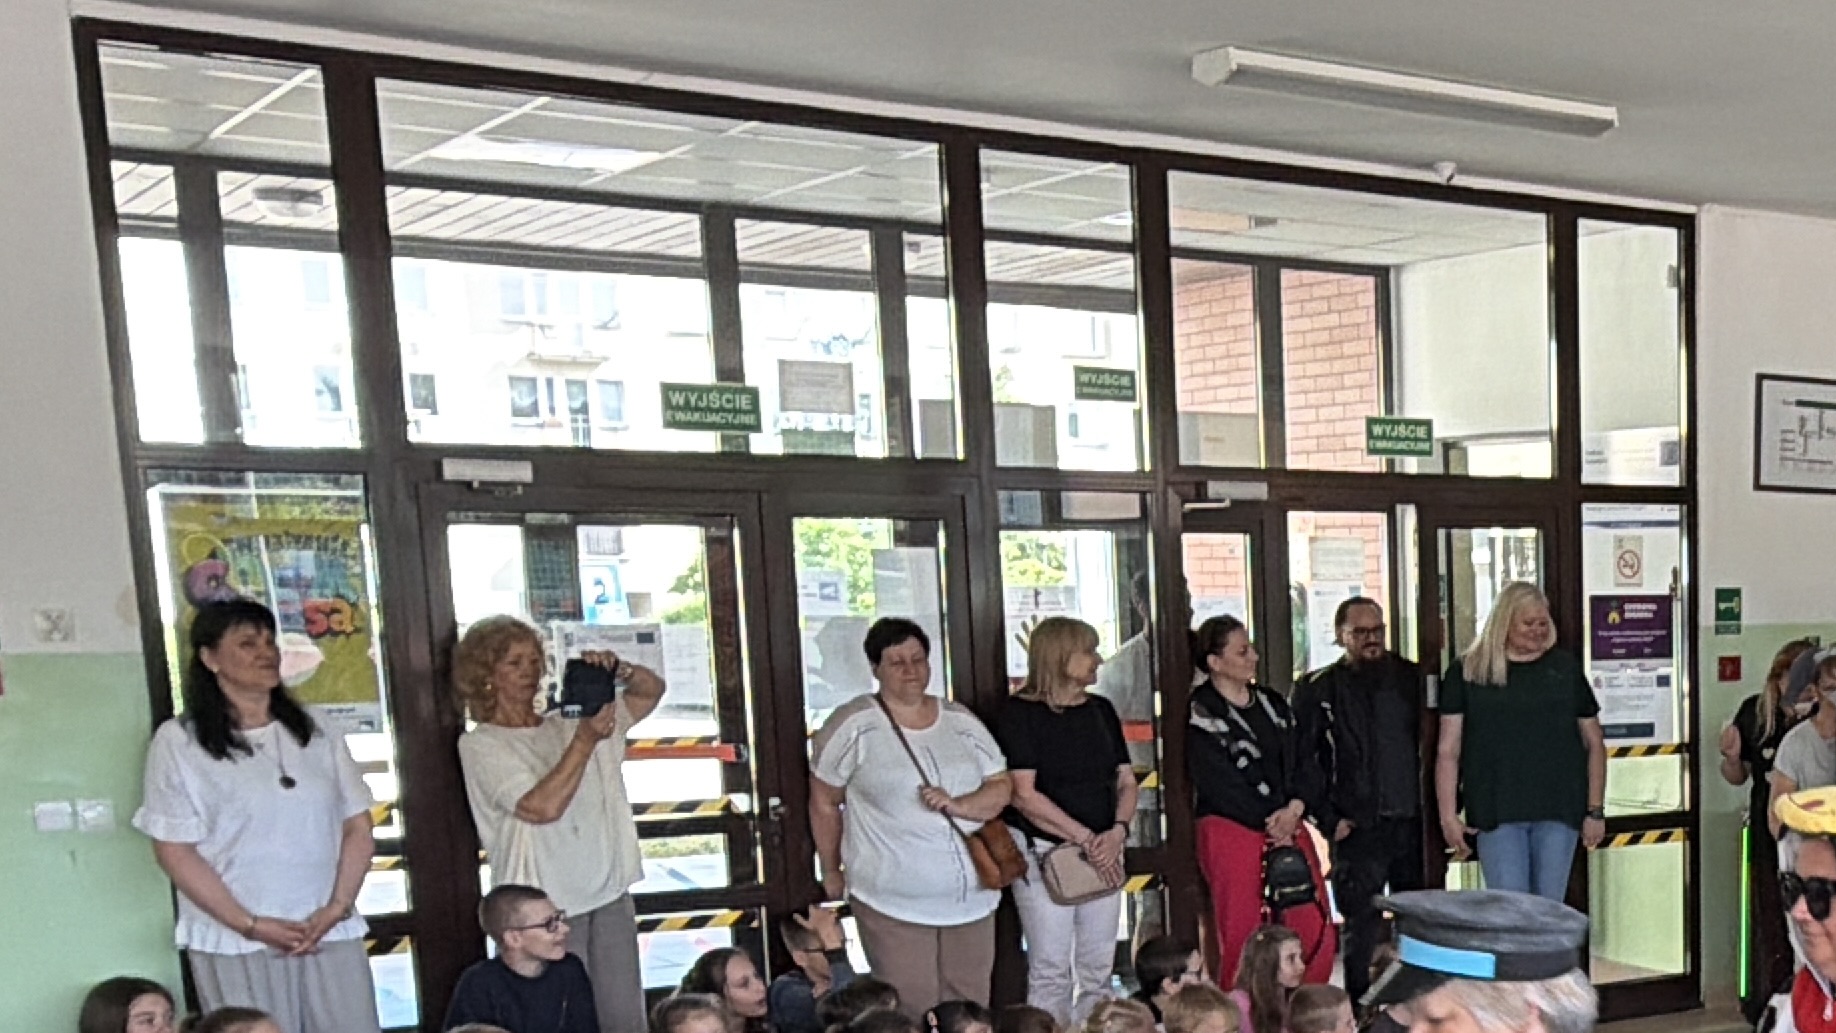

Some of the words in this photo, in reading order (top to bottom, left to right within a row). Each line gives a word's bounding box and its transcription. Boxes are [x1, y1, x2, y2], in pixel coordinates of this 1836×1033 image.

[668, 389, 752, 410] WYJŚCIE
[665, 410, 758, 426] EWAKUACYJNE
[1371, 423, 1428, 439] WYJŚCIE
